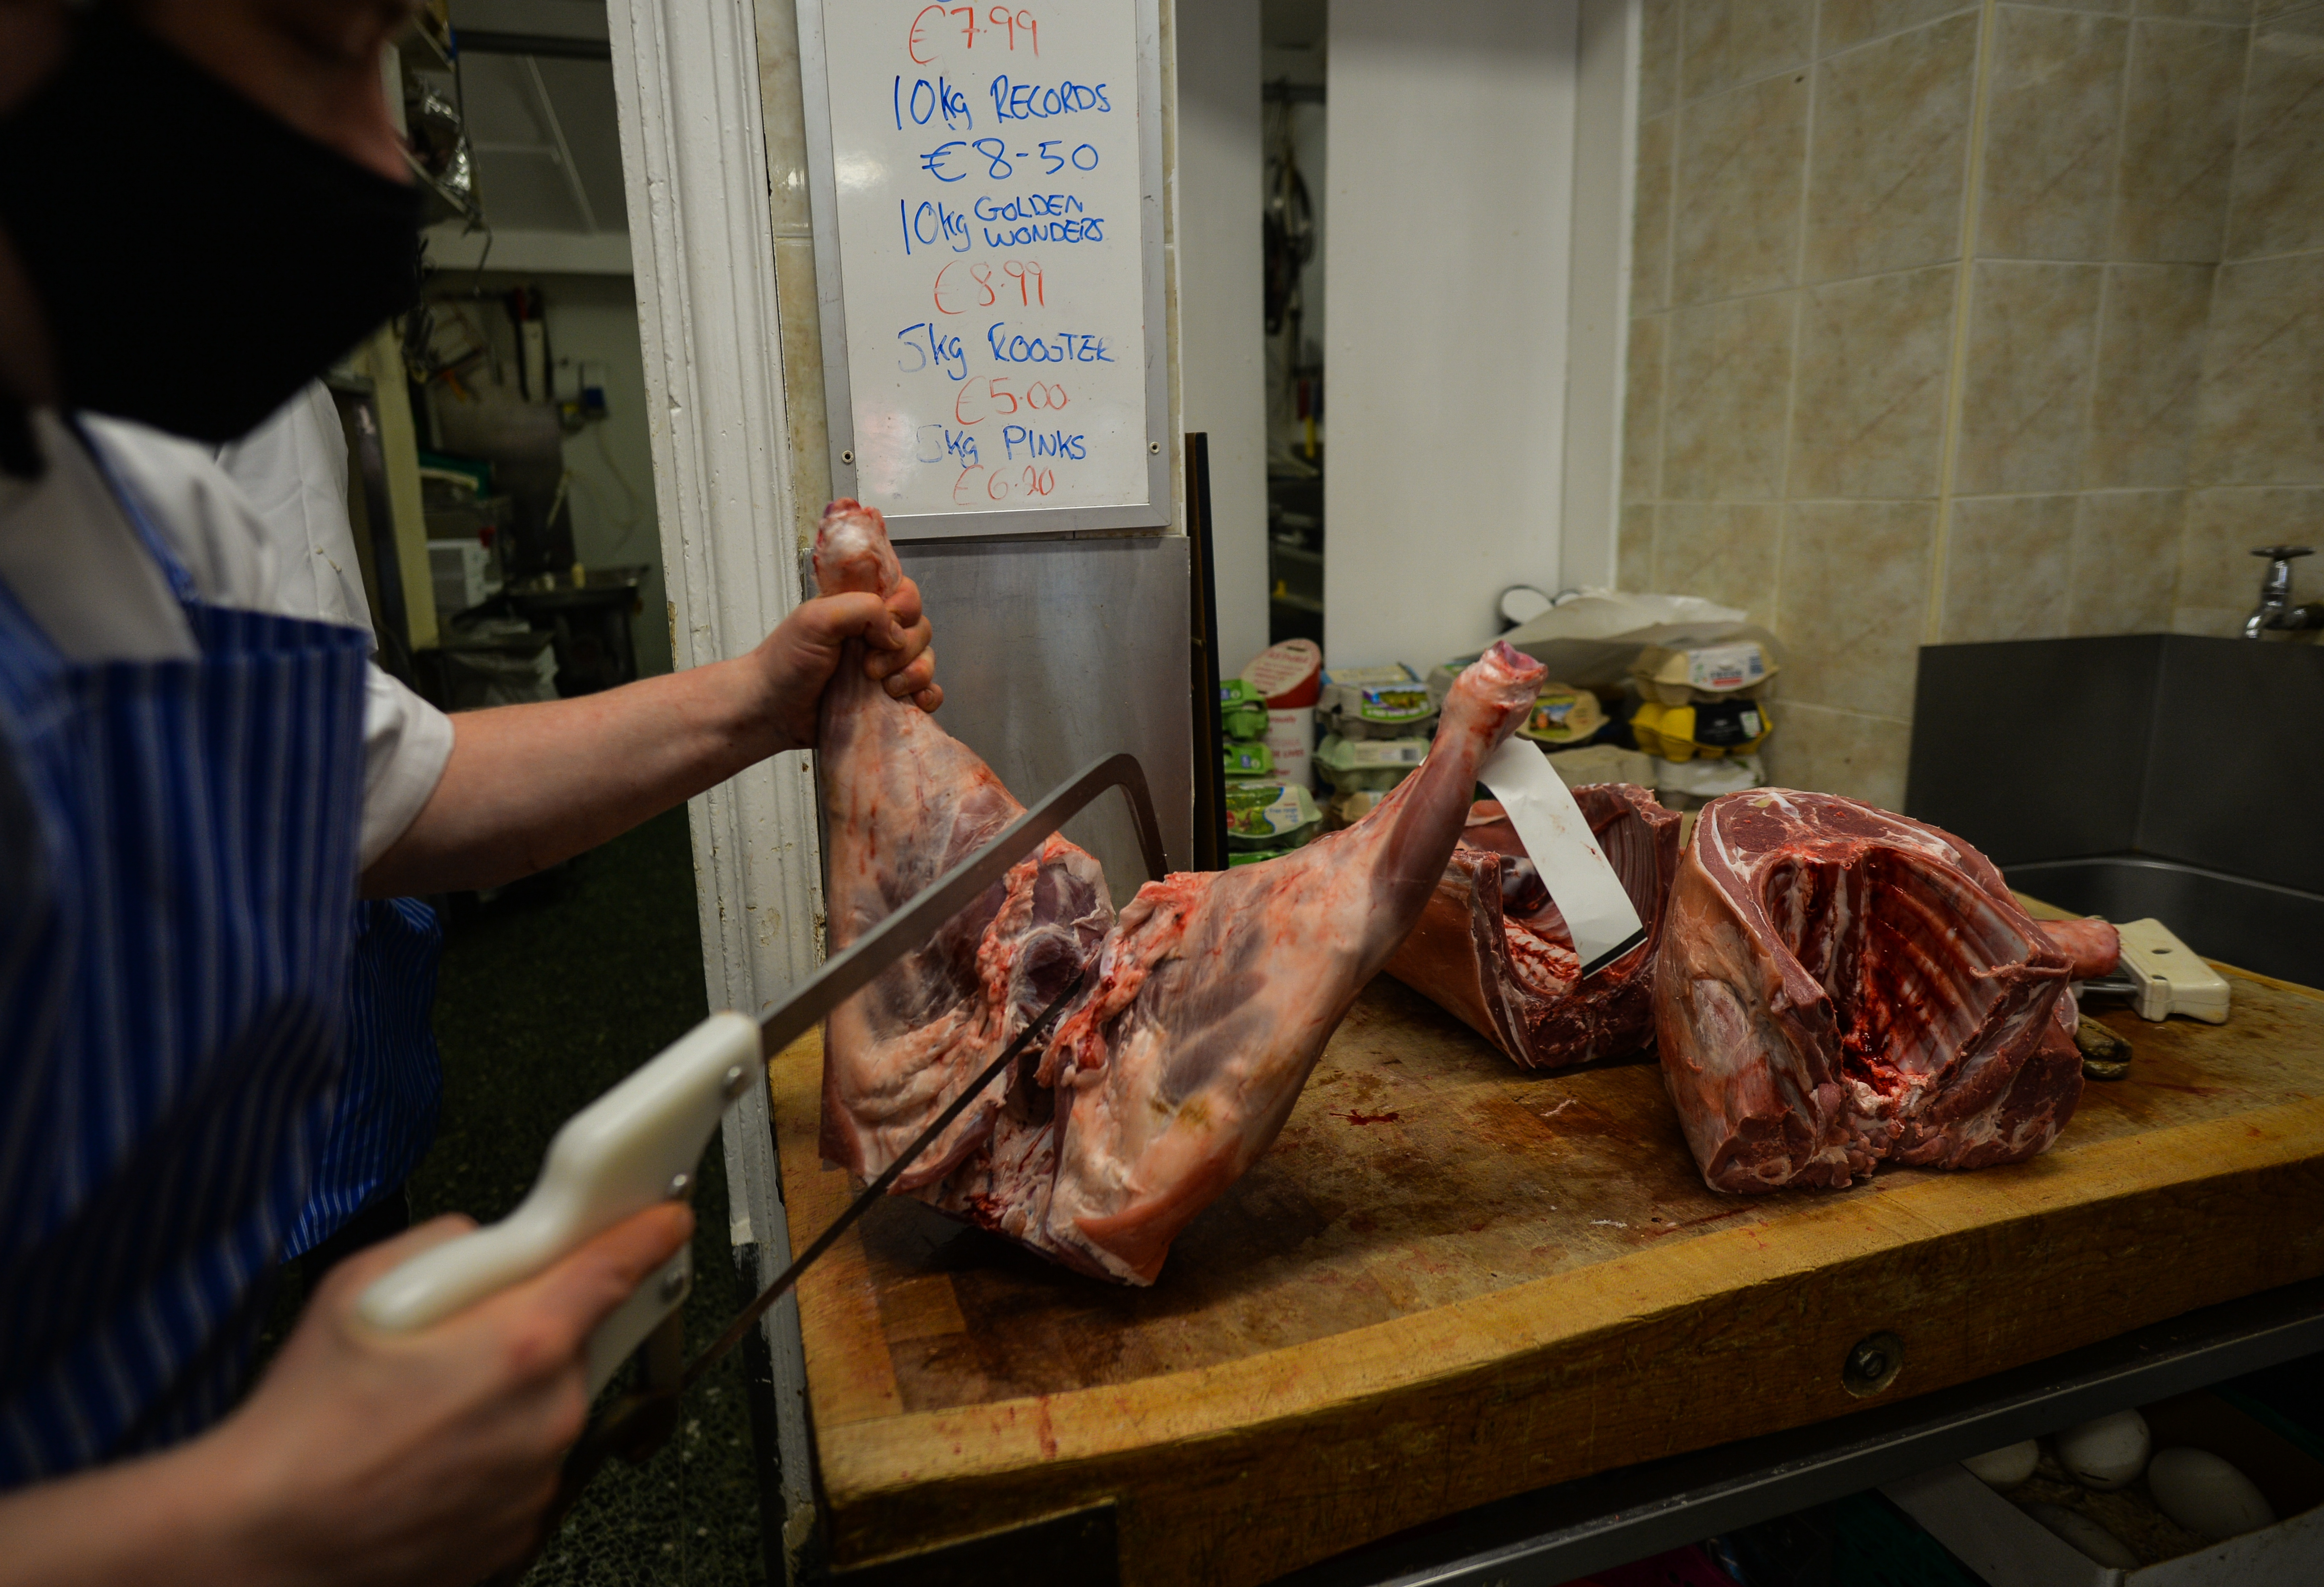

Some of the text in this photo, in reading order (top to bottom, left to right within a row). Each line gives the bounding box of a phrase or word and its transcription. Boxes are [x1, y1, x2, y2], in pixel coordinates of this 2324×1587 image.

[909, 5, 1039, 64] €7.99
[895, 75, 1111, 130] 10kg RECORDS
[901, 194, 1083, 255] 10kg GOLDEN
[984, 218, 1104, 248] WONDERS
[933, 261, 1044, 314] €8.99
[898, 323, 967, 380] 5kg
[955, 376, 1069, 425] €5.00
[916, 424, 1086, 468] 5kg PINKS
